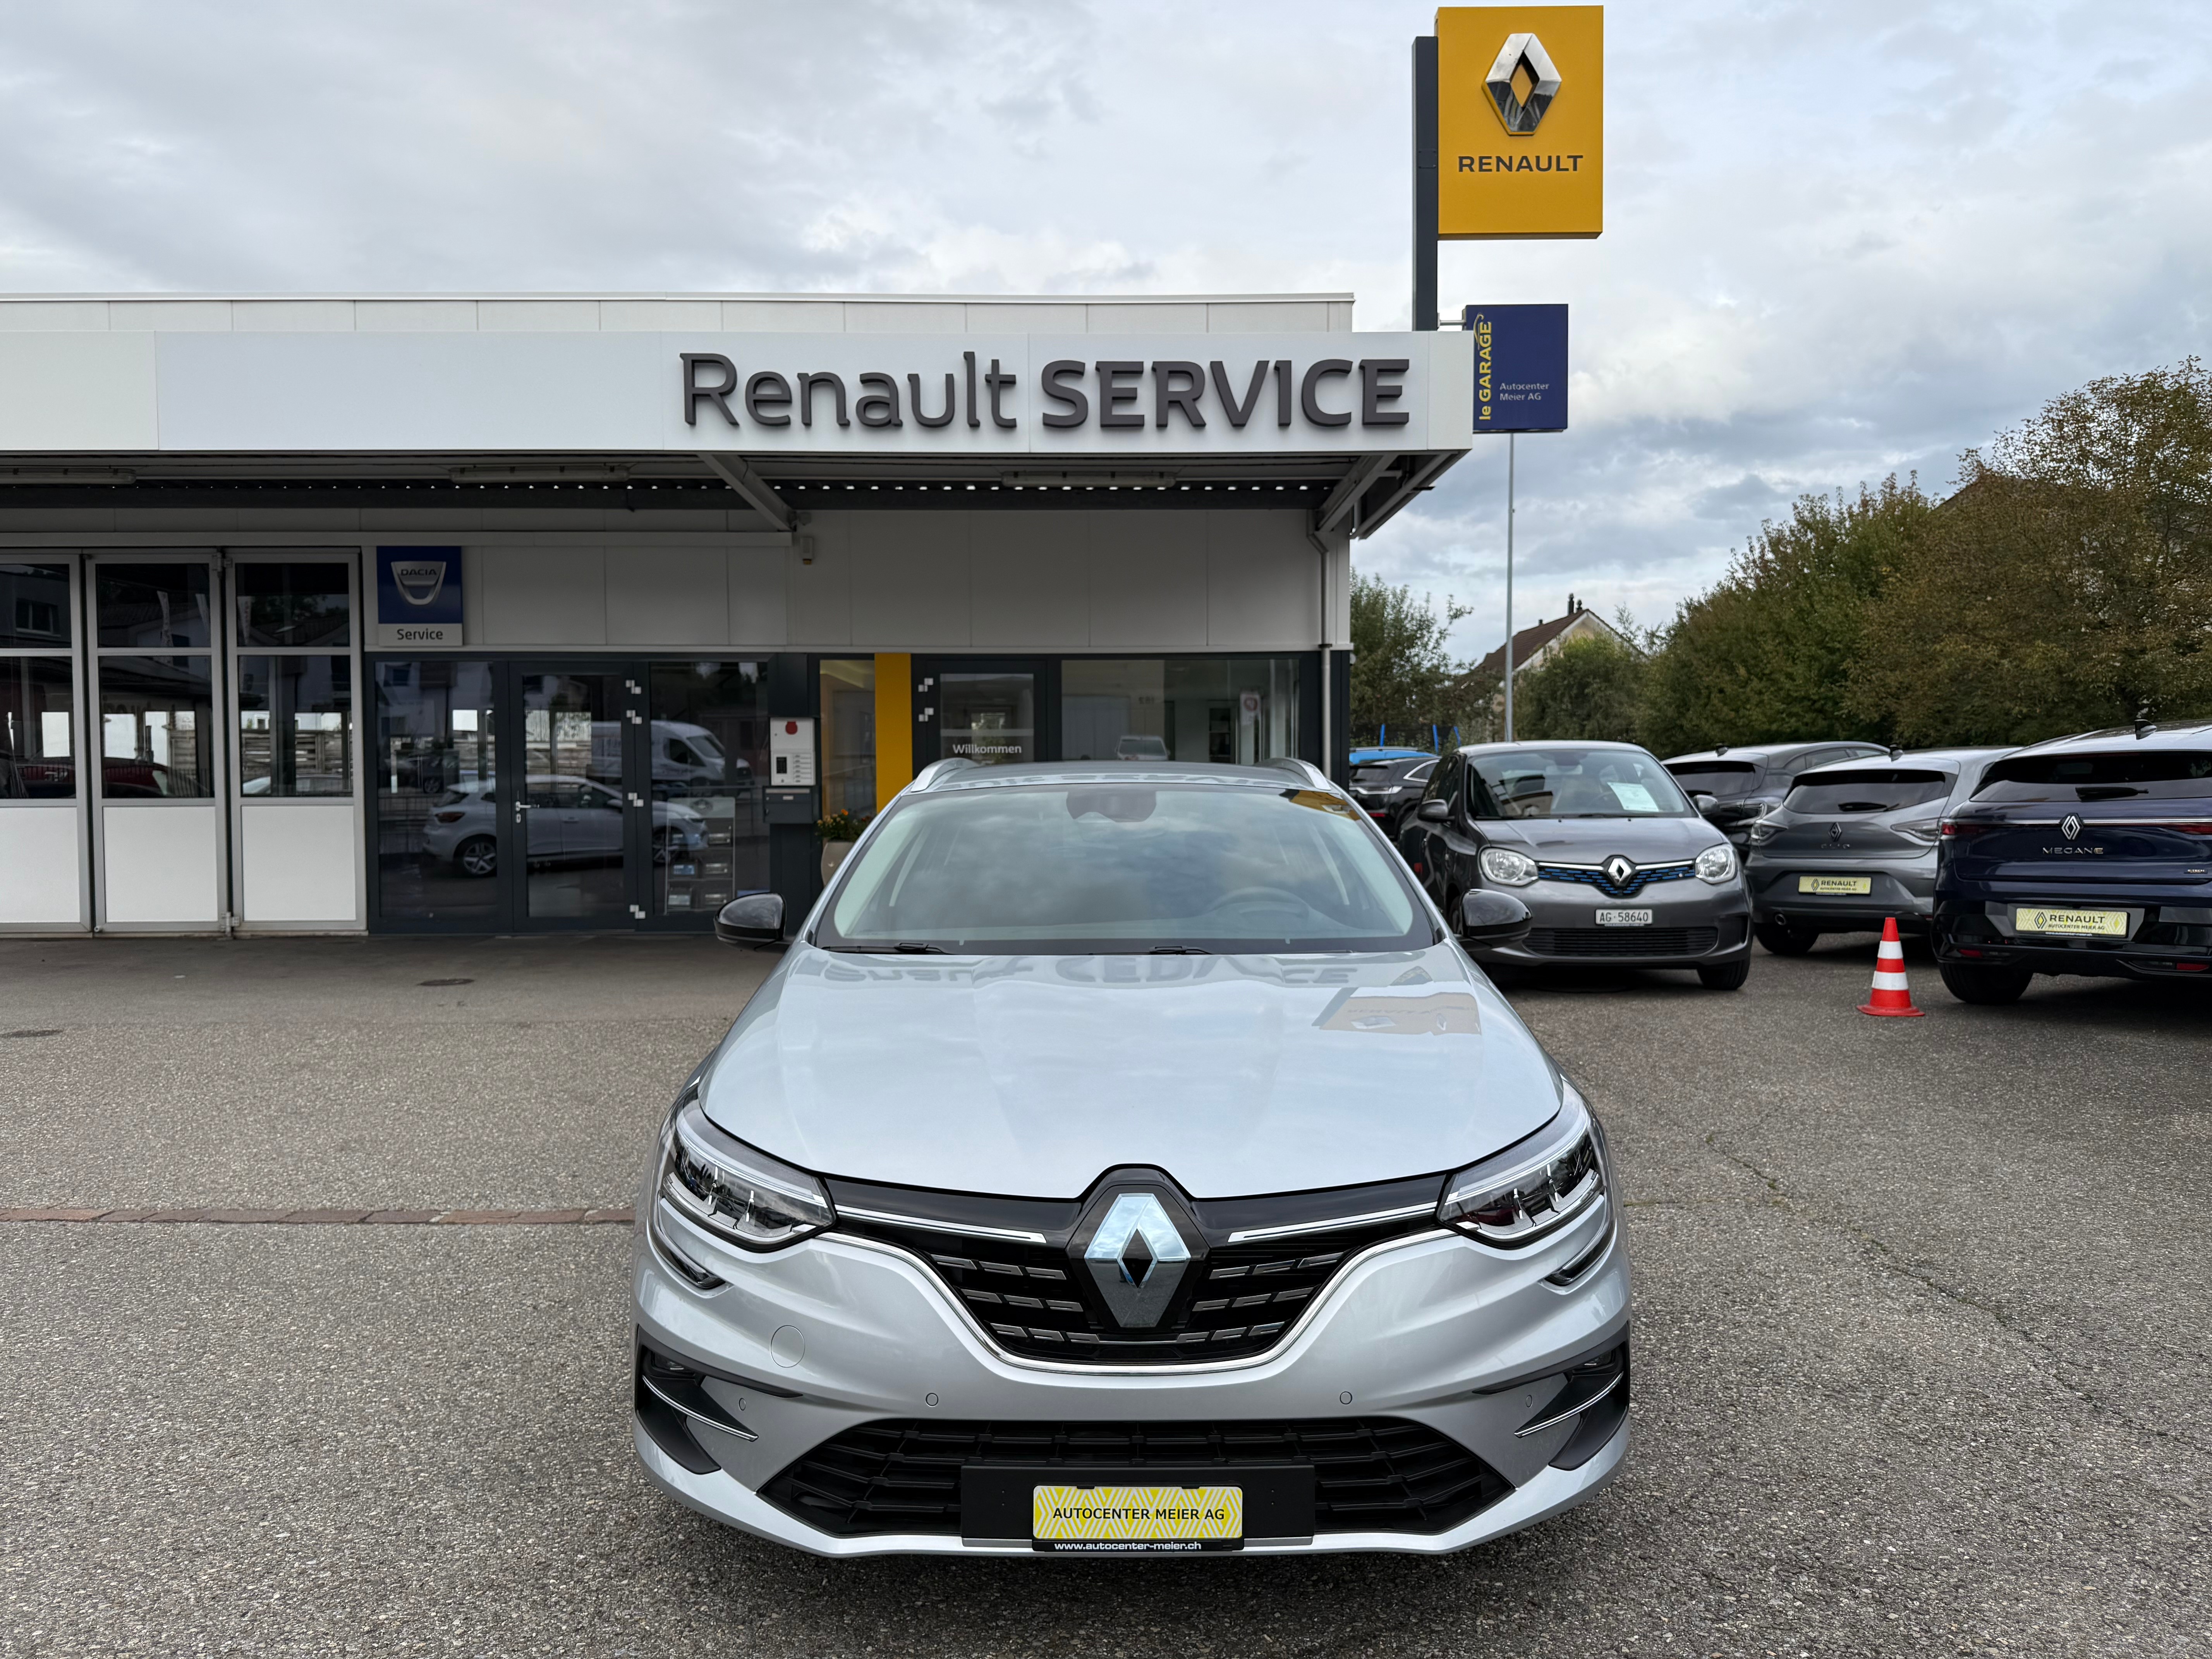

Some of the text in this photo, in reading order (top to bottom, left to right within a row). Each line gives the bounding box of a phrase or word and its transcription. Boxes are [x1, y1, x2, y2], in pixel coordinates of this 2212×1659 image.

[1458, 155, 1583, 172] RENAULT
[1479, 321, 1492, 420] le GARAGE
[680, 351, 1410, 428] Renault SERVICE
[1527, 392, 1542, 400] AG
[397, 628, 443, 640] Service
[952, 744, 1022, 754] Willkommen
[1600, 912, 1648, 922] AG 58640
[2049, 914, 2105, 924] RENAULT
[1053, 1508, 1224, 1520] AUTOCENTER MEIER AG
[1054, 1541, 1202, 1549] www.autocenter-meier.ch
